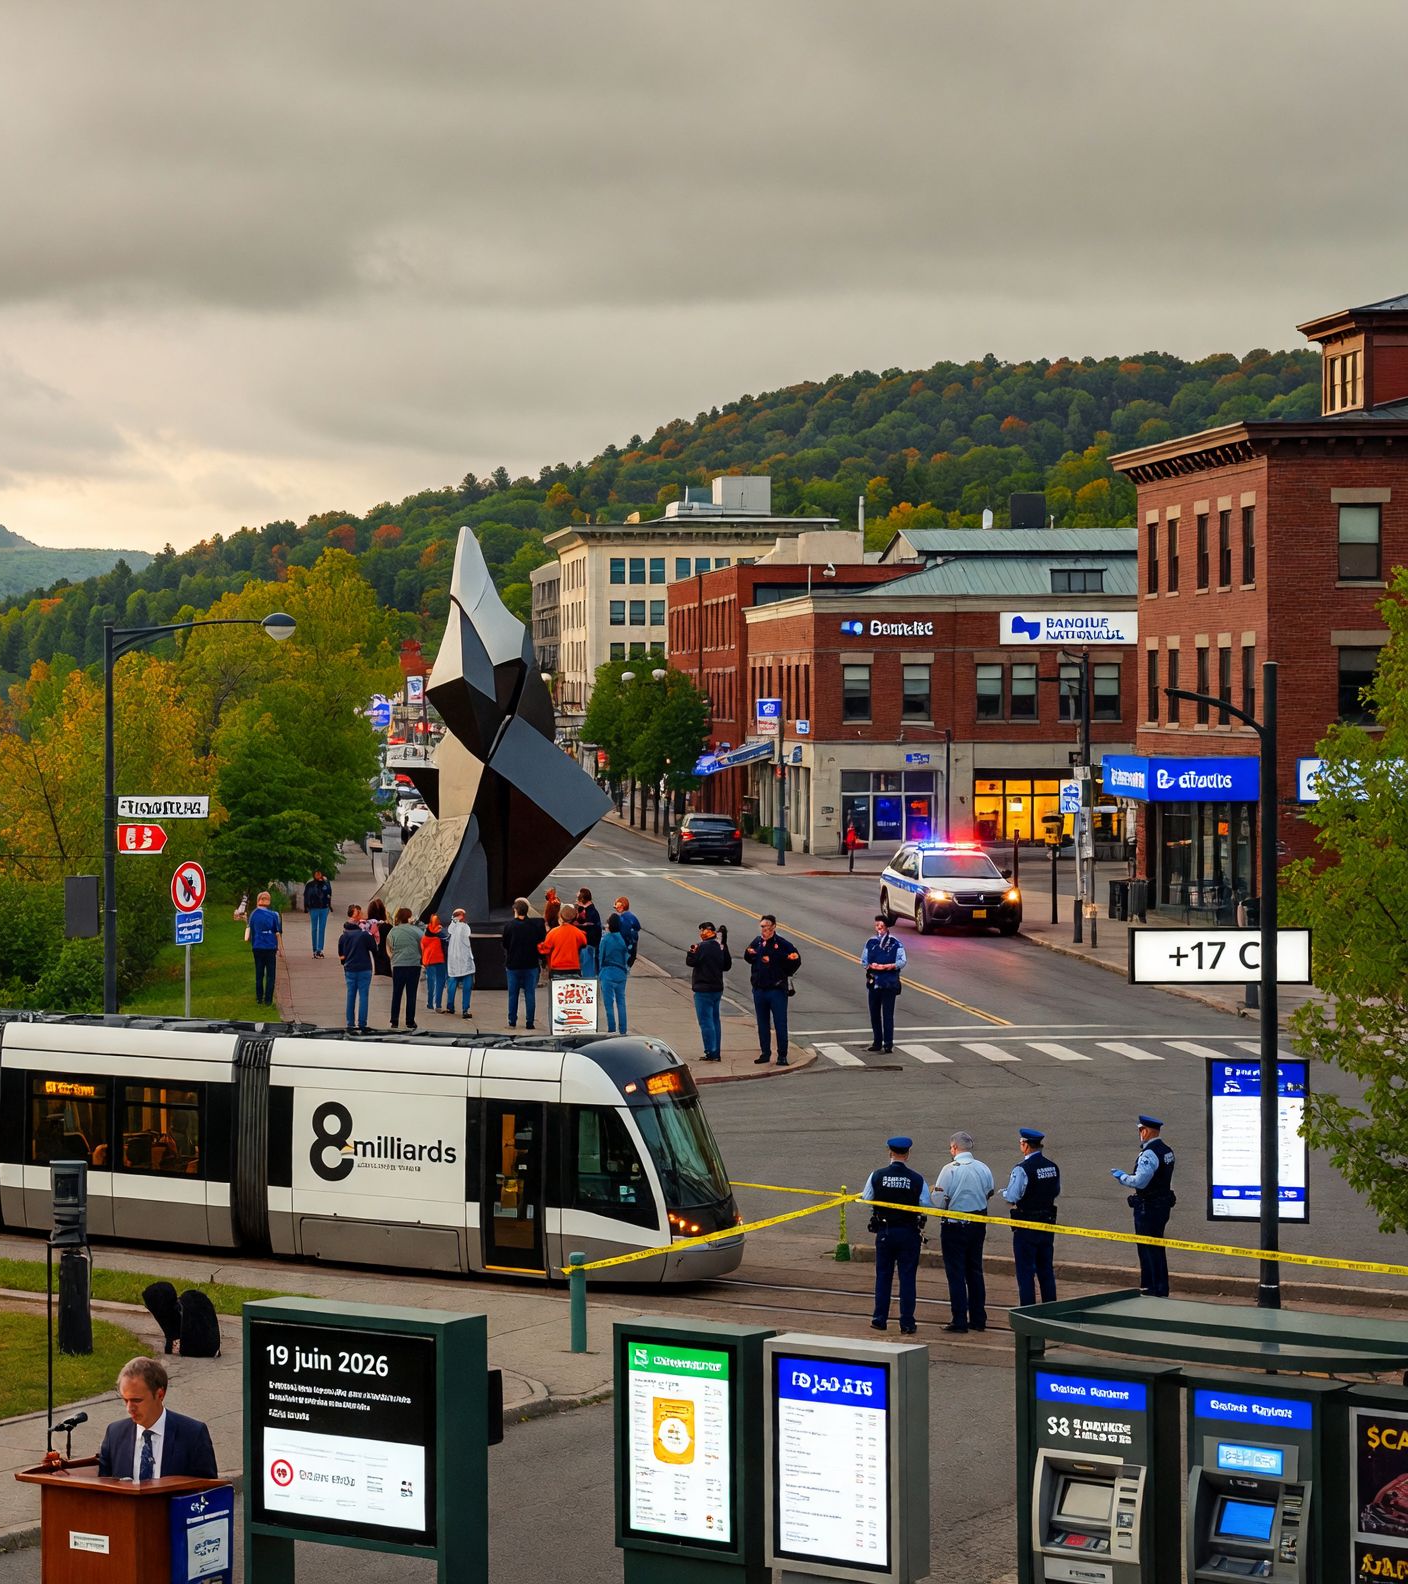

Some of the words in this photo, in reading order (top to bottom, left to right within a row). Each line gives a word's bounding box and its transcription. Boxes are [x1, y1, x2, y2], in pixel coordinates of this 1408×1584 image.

[1169, 941, 1226, 970] +17
[309, 1101, 355, 1182] 8
[353, 1135, 457, 1164] milliards
[266, 1344, 289, 1366] 19
[293, 1346, 332, 1373] juin
[338, 1351, 389, 1377] 2026
